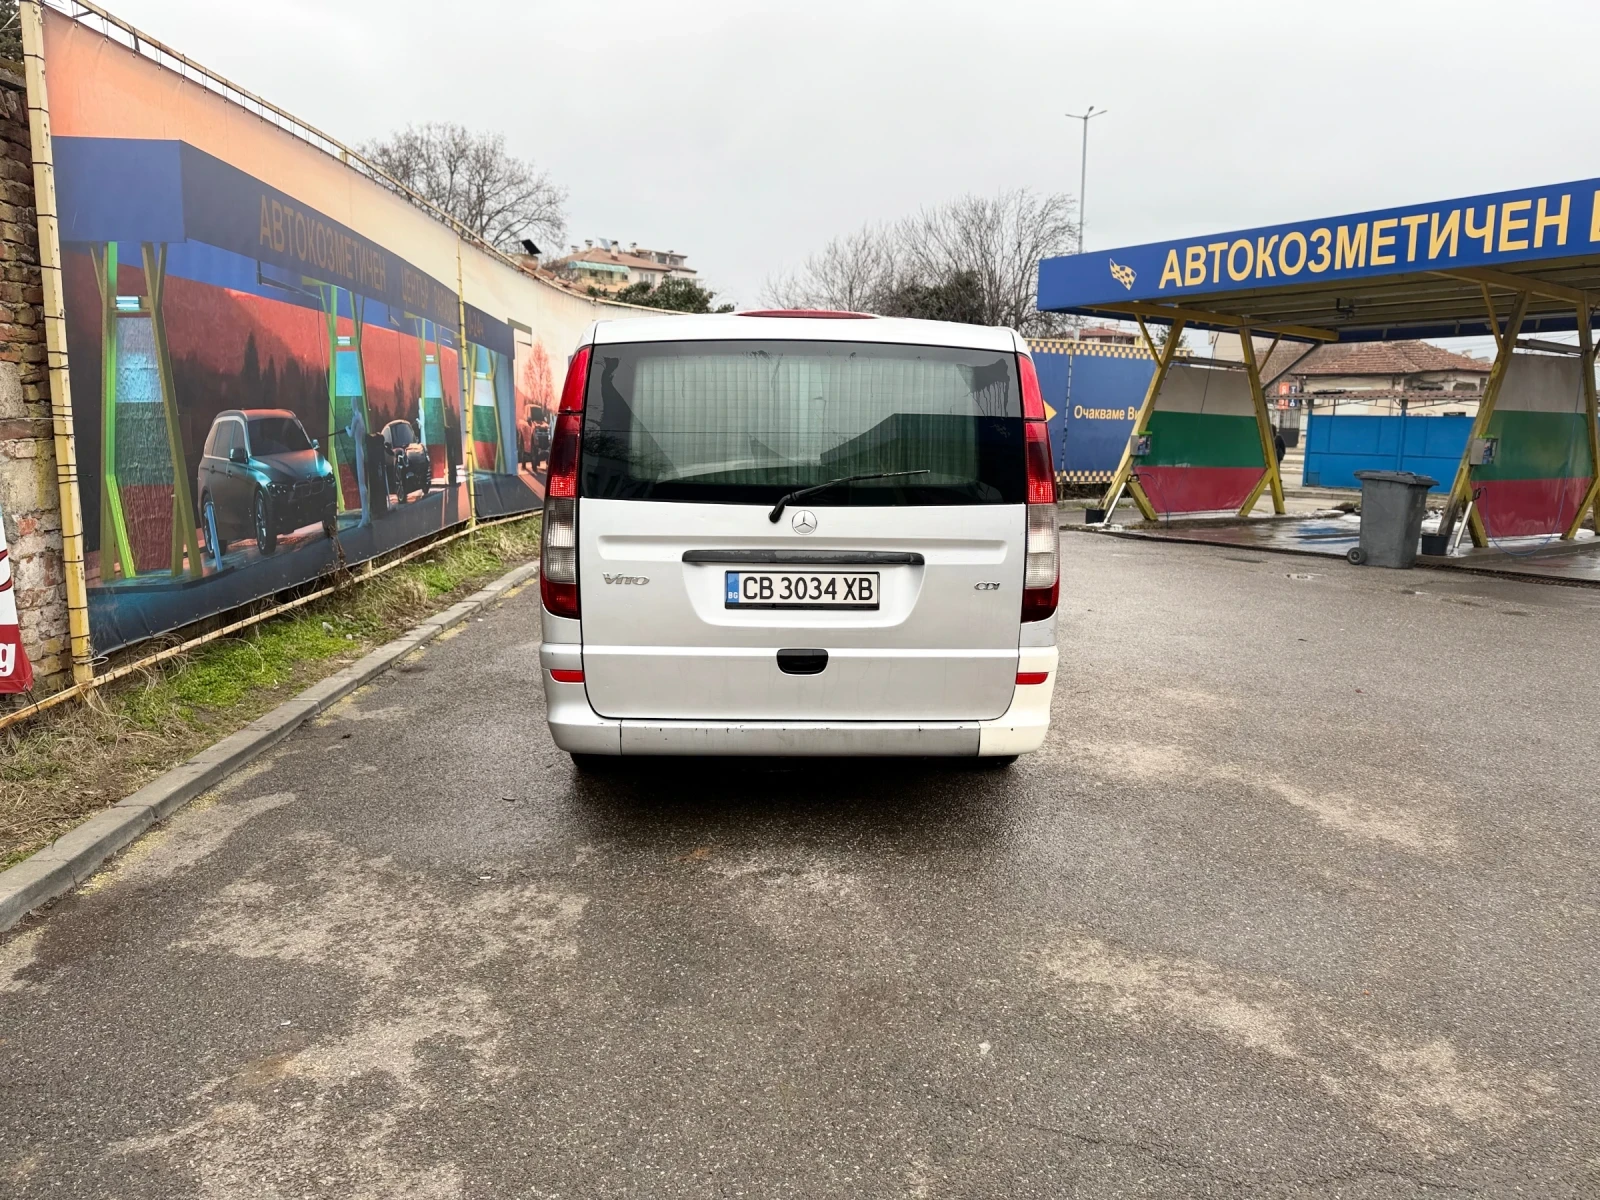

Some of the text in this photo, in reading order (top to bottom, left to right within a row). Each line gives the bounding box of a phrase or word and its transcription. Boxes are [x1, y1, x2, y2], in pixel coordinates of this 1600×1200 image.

[260, 194, 386, 292] АВТОКОЗМЕТИЧЕН
[1158, 194, 1571, 290] АВТОКОЗМЕТИЧЕН
[1074, 405, 1125, 420] Очакваме
[728, 591, 739, 599] BG
[779, 577, 837, 600] 3034
